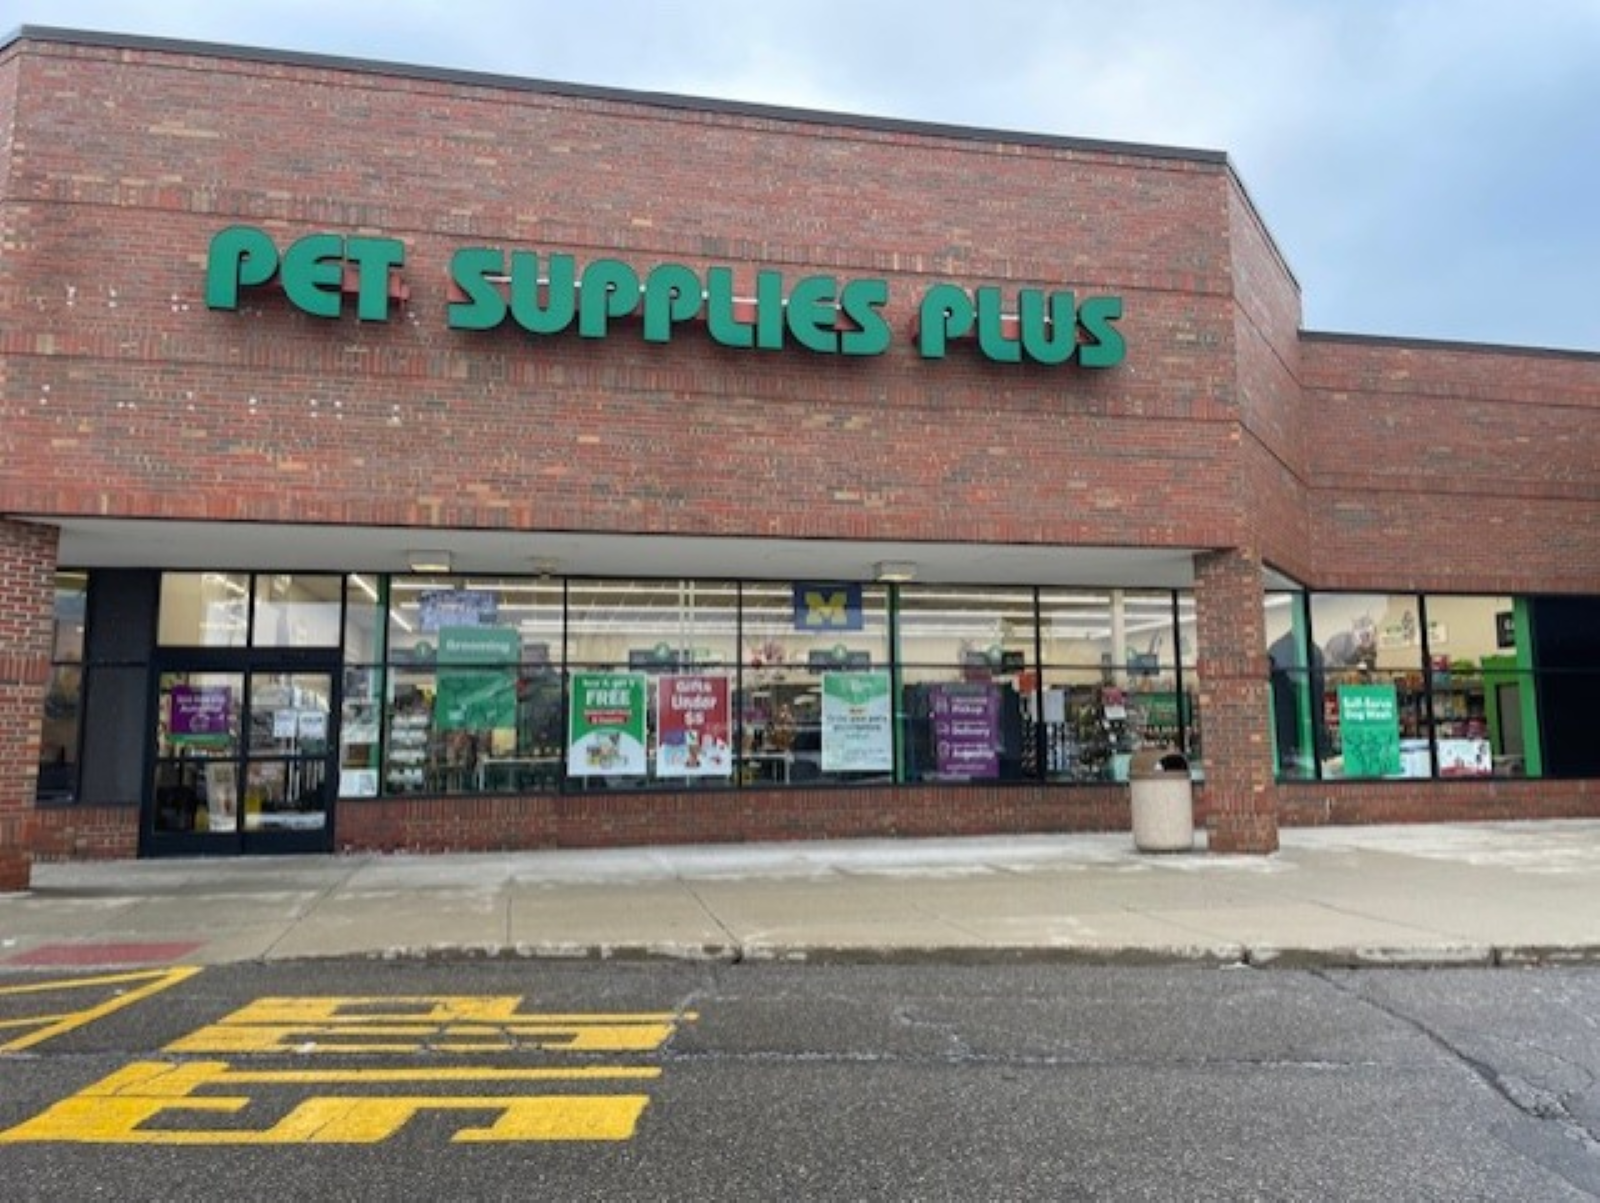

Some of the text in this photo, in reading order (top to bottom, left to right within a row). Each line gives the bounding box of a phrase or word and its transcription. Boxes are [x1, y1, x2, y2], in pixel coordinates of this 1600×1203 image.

[205, 224, 1126, 367] PET SUPPLIES PLUS
[676, 679, 711, 693] Gifts
[586, 690, 630, 706] FREE
[671, 694, 718, 710] Under
[0, 995, 699, 1142] STOP
